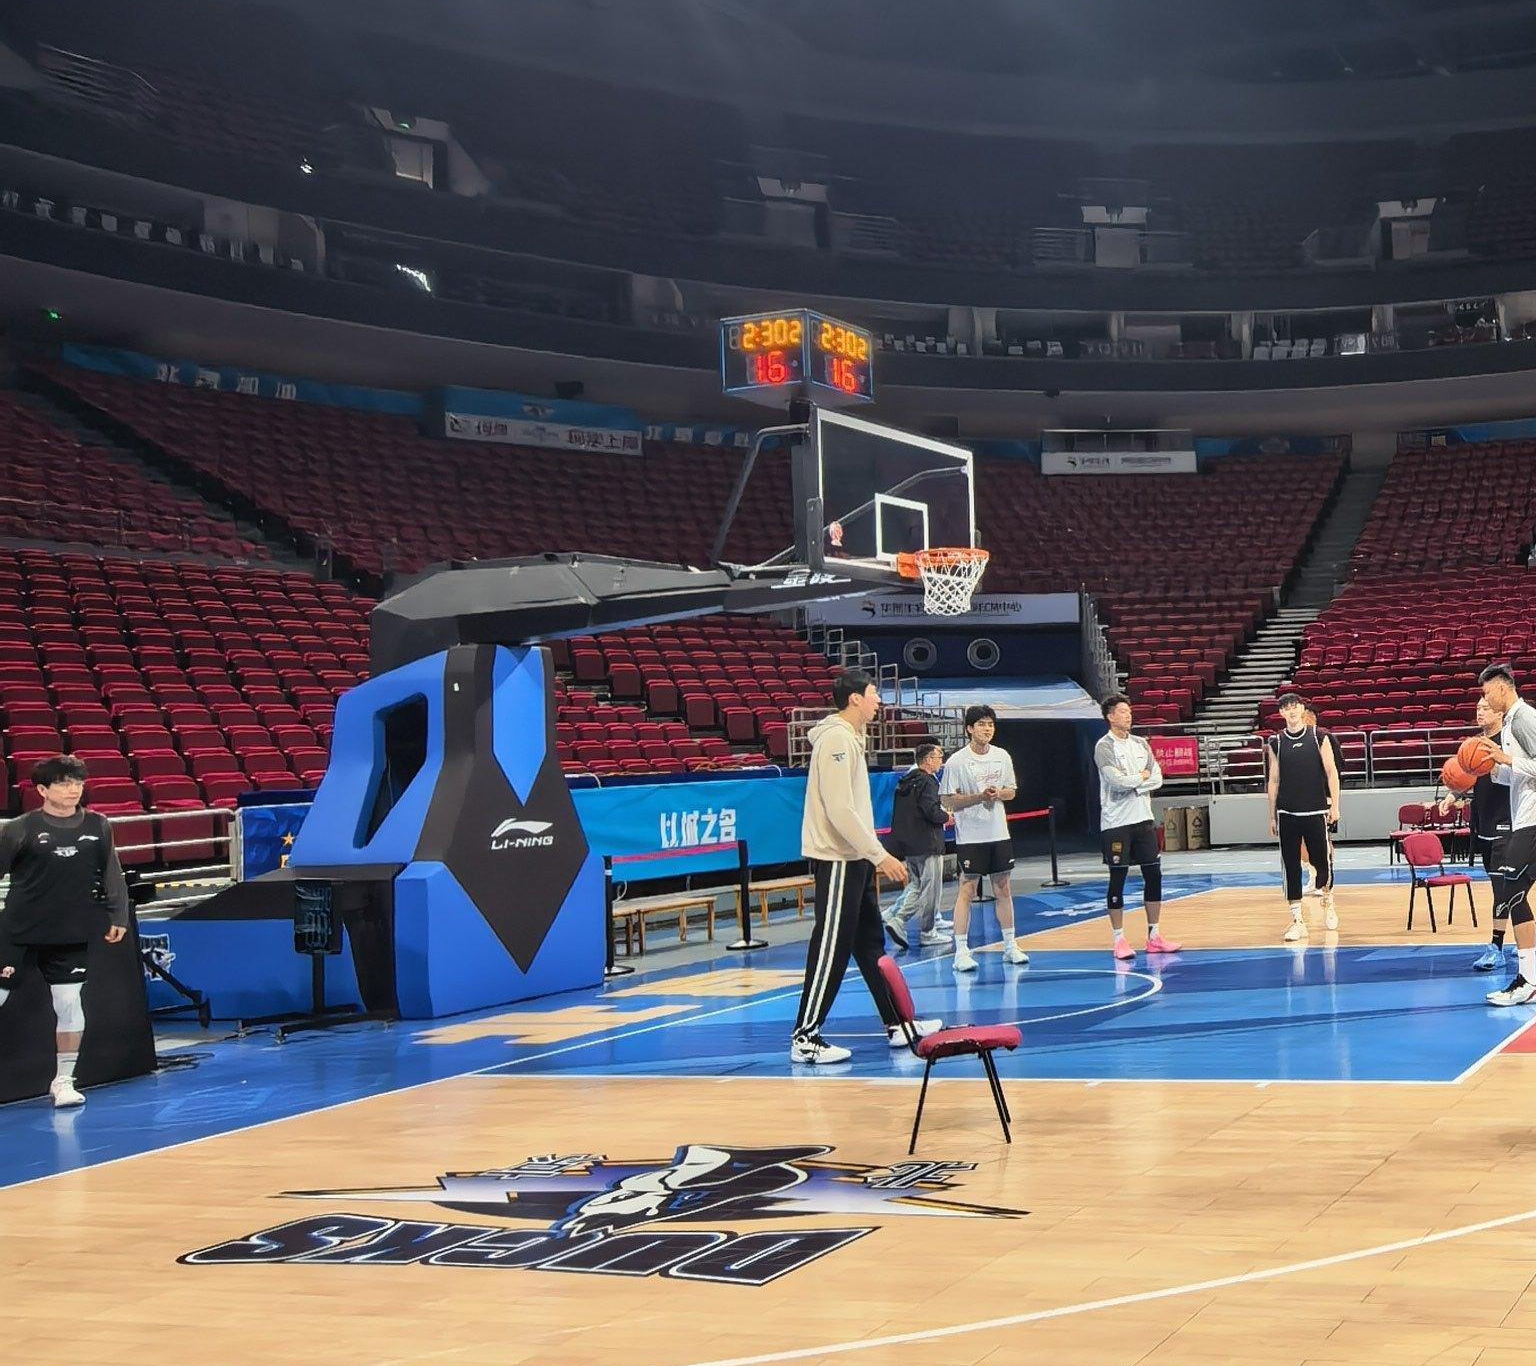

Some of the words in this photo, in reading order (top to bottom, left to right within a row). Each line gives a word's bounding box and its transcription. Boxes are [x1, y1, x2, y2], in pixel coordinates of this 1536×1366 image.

[756, 351, 787, 383] 16
[832, 349, 857, 394] 16
[491, 835, 554, 851] LI-NING
[660, 808, 737, 848] 以城之名
[174, 1213, 882, 1287] DUCKS
